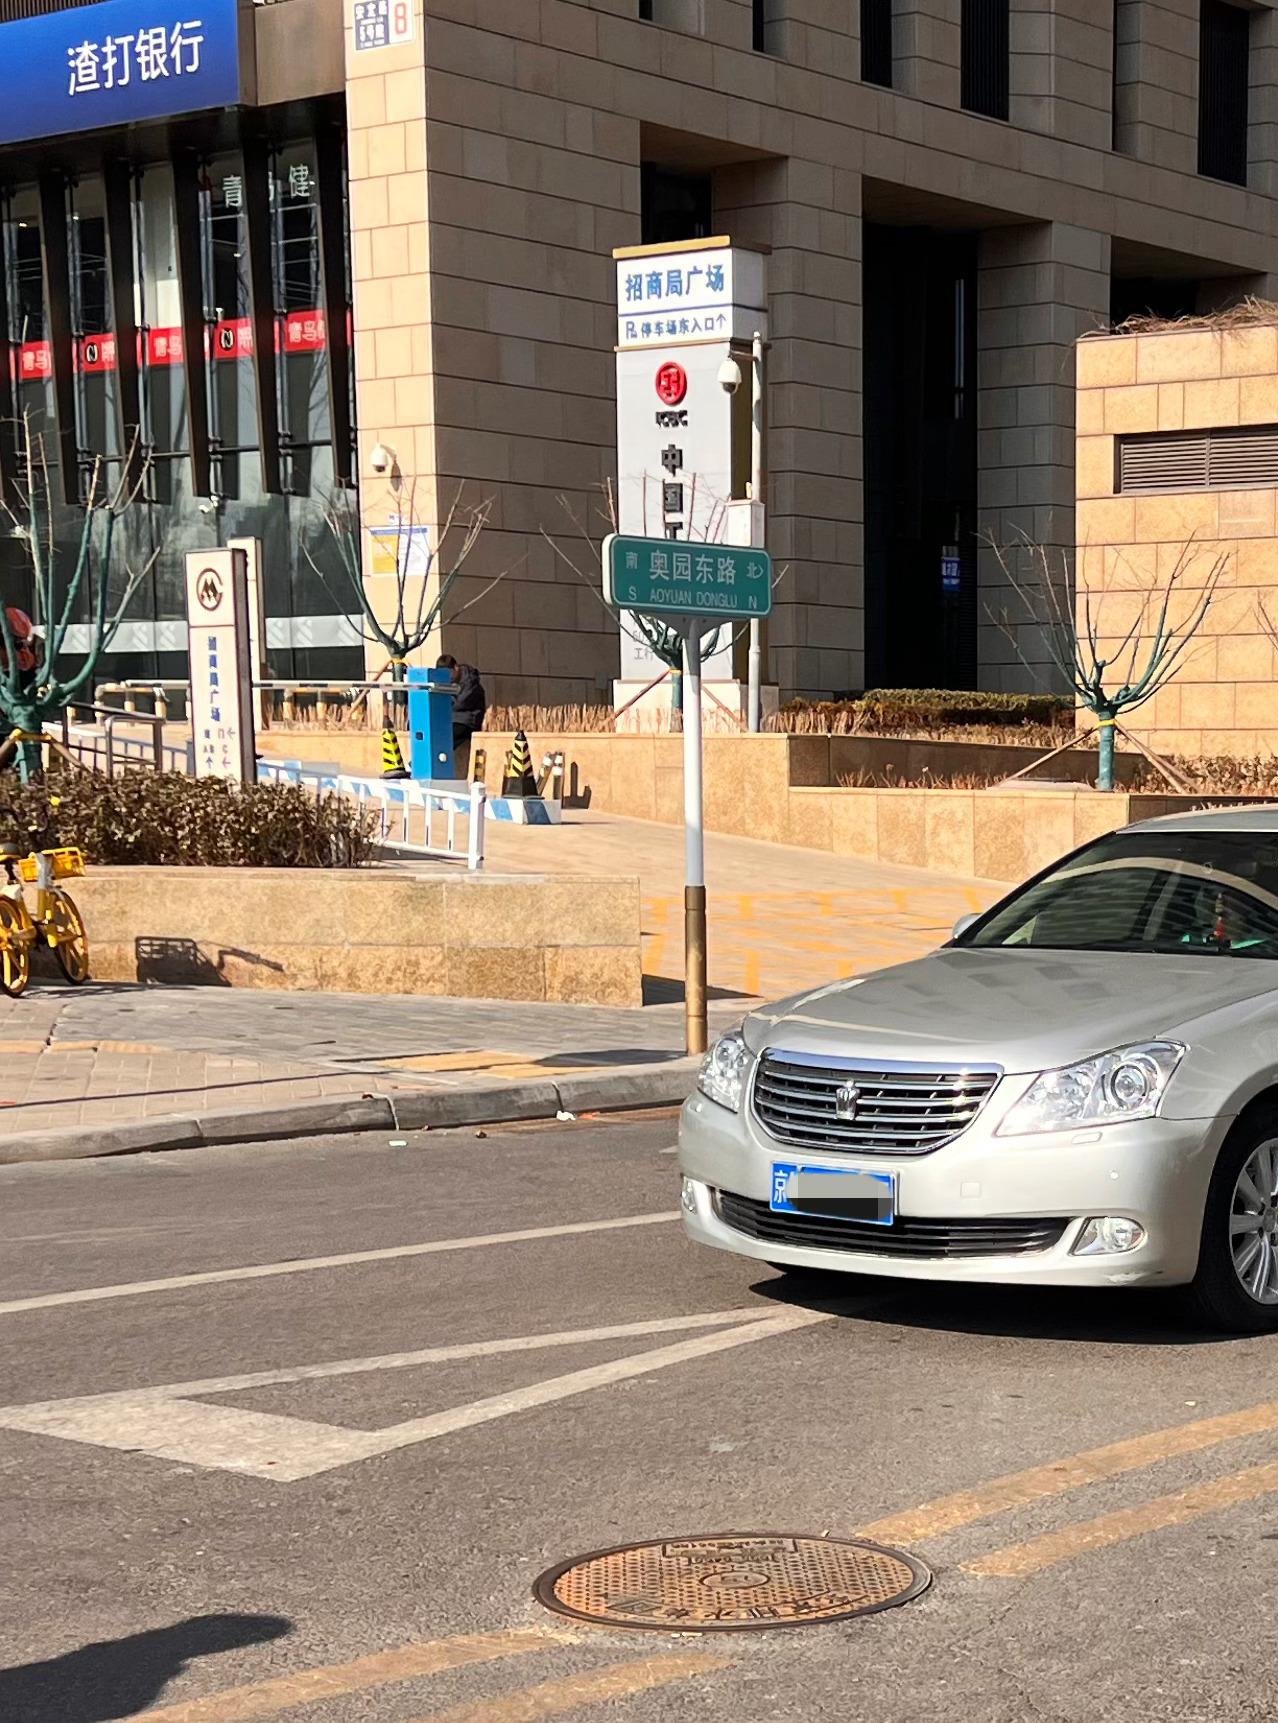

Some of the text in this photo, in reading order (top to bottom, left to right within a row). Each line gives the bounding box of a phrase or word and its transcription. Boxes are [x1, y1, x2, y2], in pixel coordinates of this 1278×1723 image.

[394, 2, 407, 35] 8
[67, 20, 204, 96] 渣打银行
[625, 264, 724, 302] 招商局广场
[641, 317, 714, 338] 停车场东入口
[626, 552, 638, 569] 南
[649, 550, 737, 585] 奥园东路
[746, 562, 761, 579] 北
[628, 586, 637, 601] S
[650, 588, 737, 608] AOYUAN DONGLU
[749, 595, 758, 609] N
[774, 1170, 788, 1204] 京
